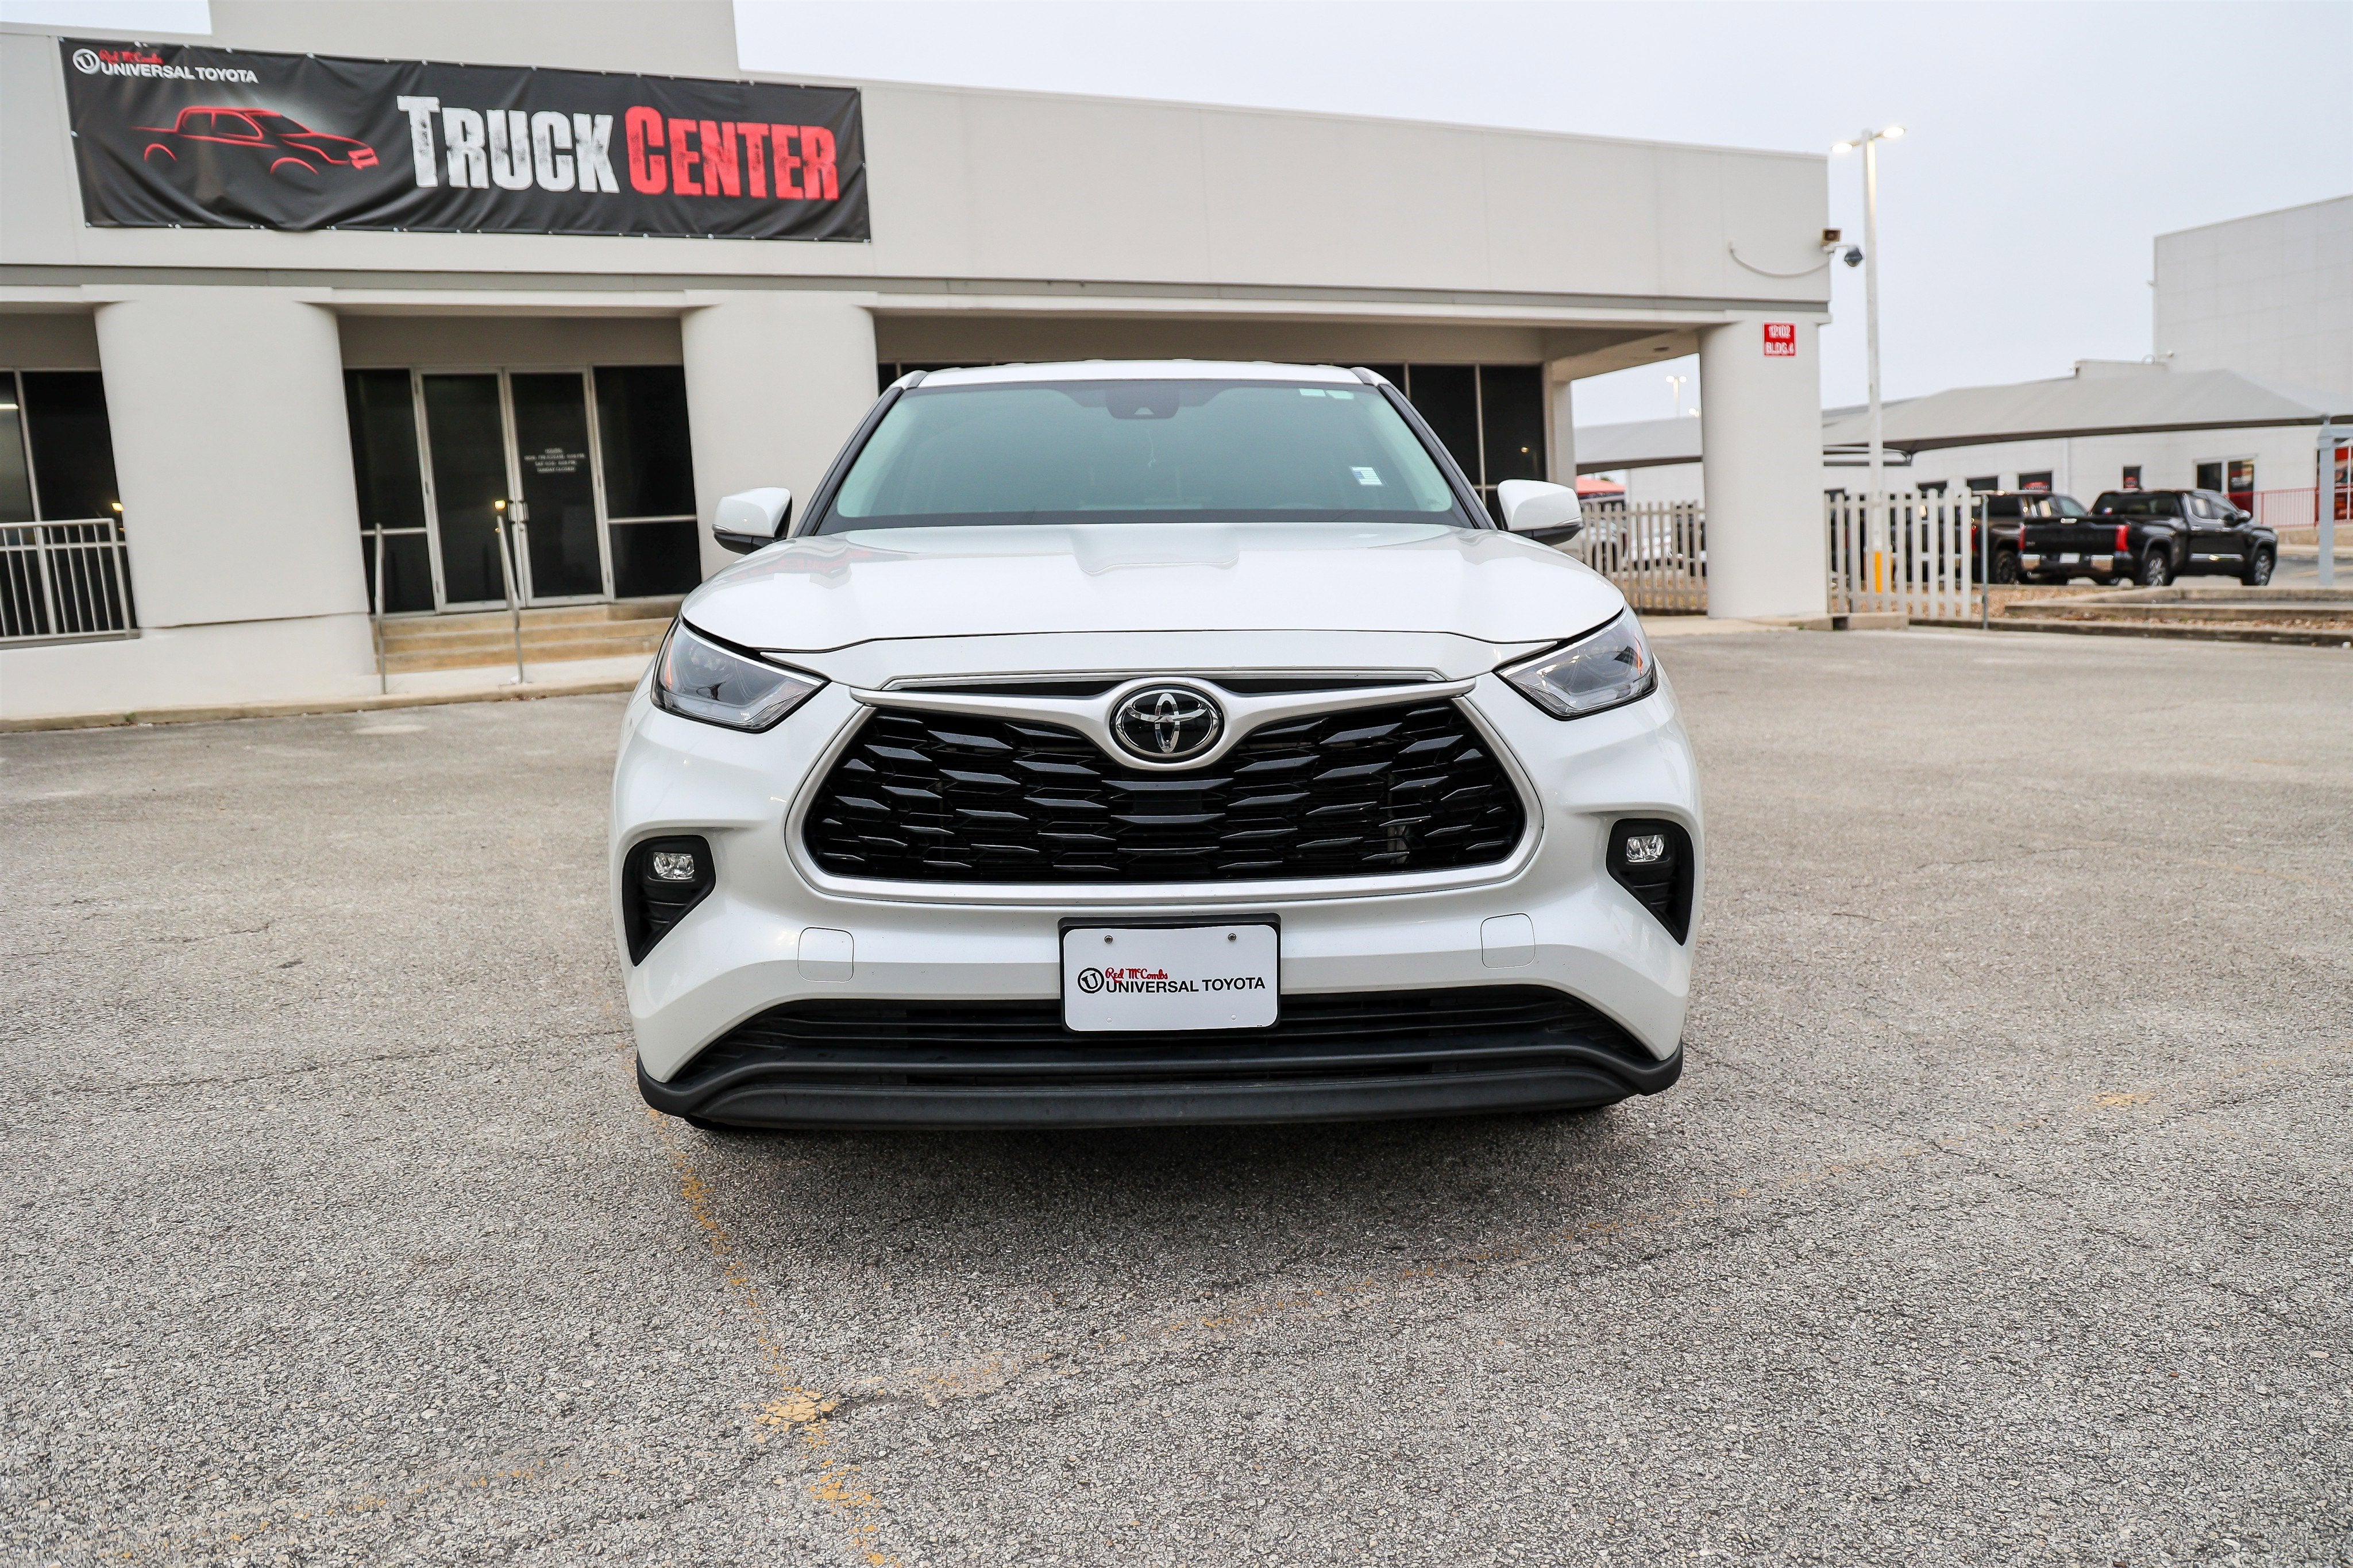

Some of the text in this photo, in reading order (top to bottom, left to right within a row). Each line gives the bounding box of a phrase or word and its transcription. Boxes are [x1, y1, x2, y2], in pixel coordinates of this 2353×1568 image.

[101, 61, 260, 84] UNIVERSAL TOYOTA
[397, 95, 840, 200] TRUCK CENTER
[1105, 967, 1124, 983] Red
[1106, 977, 1266, 993] UNIVERSAL TOYOTA
